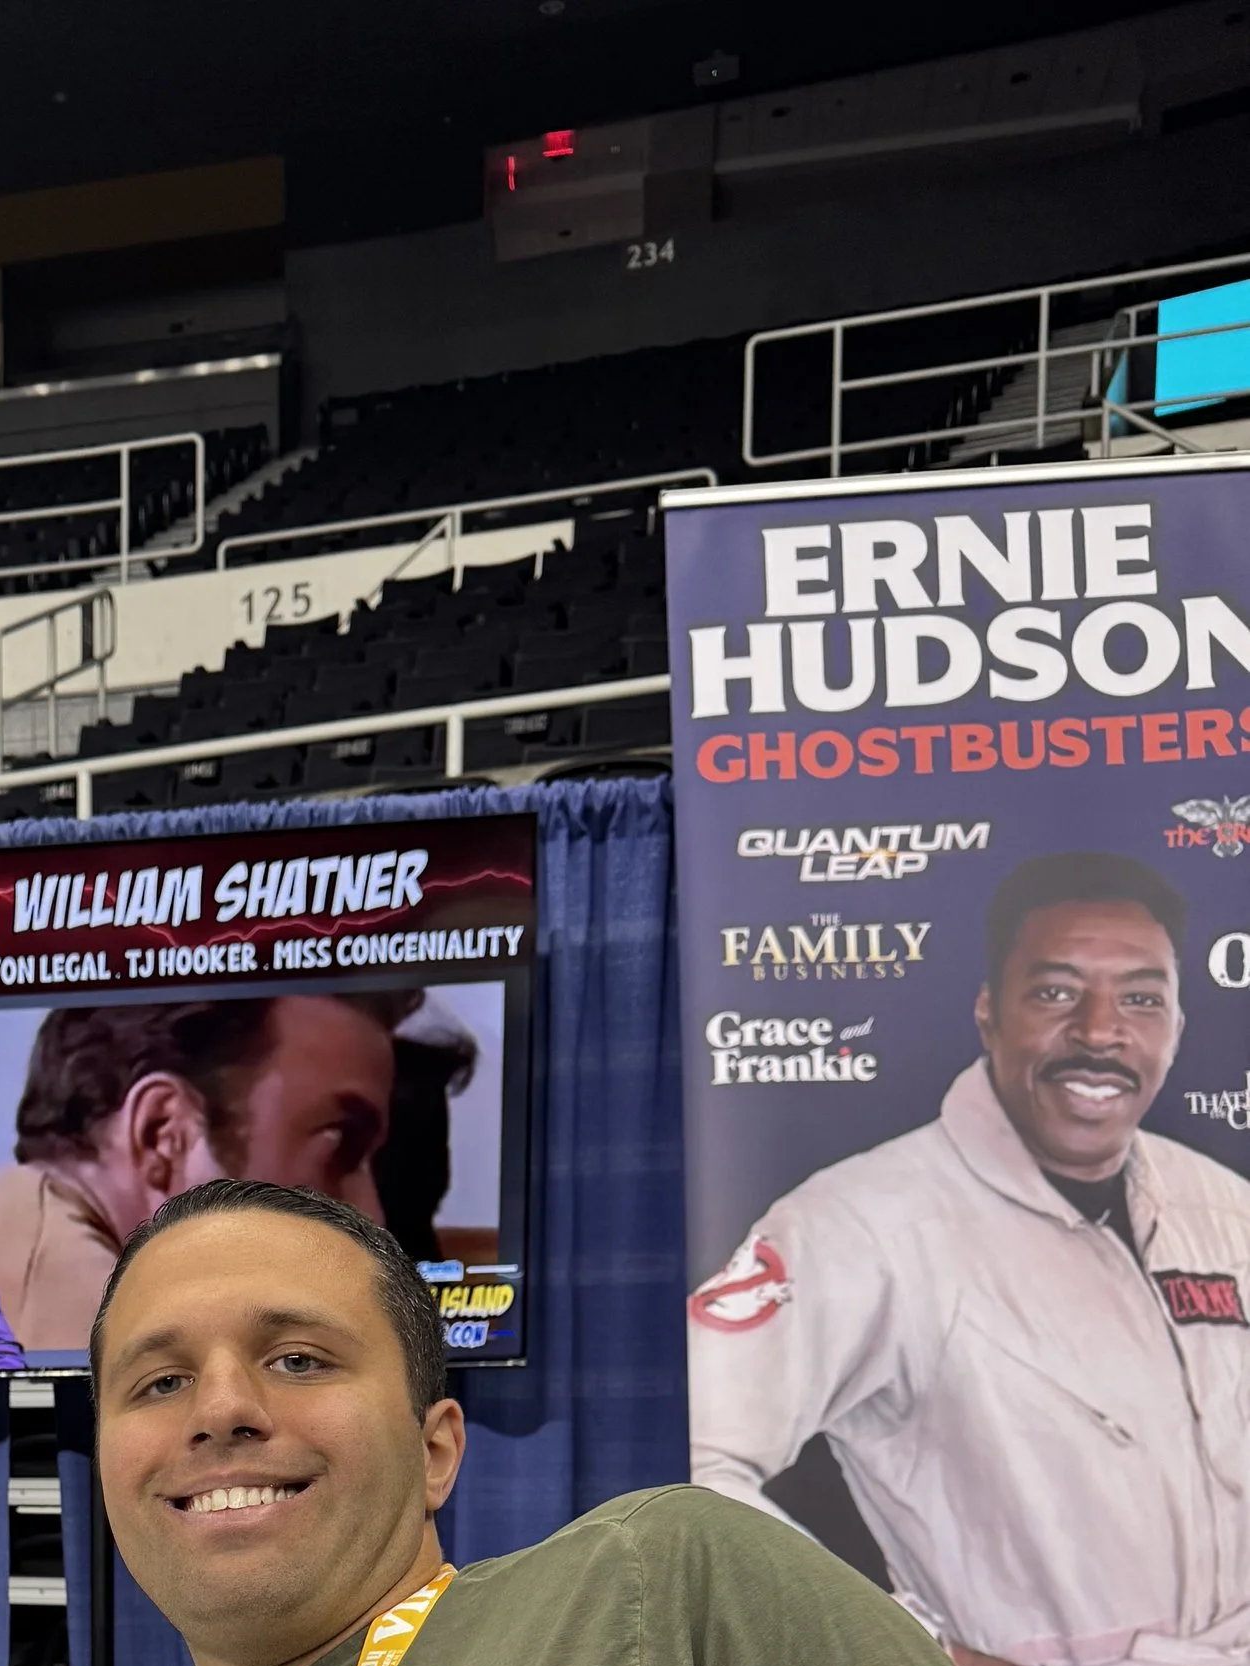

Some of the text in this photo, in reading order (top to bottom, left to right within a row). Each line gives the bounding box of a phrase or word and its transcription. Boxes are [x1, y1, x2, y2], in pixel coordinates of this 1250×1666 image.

[626, 238, 675, 269] 234
[761, 503, 1158, 618] ERNIE
[241, 582, 313, 626] 125
[737, 822, 991, 857] QUANTUM
[800, 852, 929, 882] LEAP
[13, 849, 429, 933] WILLIAM SHATNER
[810, 913, 842, 926] THE
[39, 951, 112, 984] LEGAL
[124, 948, 155, 978] TJ
[158, 942, 258, 977] HOOKER
[273, 936, 332, 970] MISS
[336, 925, 524, 967] CONGENIALITY
[720, 921, 932, 966] FAMILY
[752, 963, 906, 981] BUSINESS
[705, 1011, 874, 1048] Grace and
[710, 1046, 877, 1085] Frankie
[439, 1284, 515, 1318] ISLAND
[448, 1321, 490, 1348] CON
